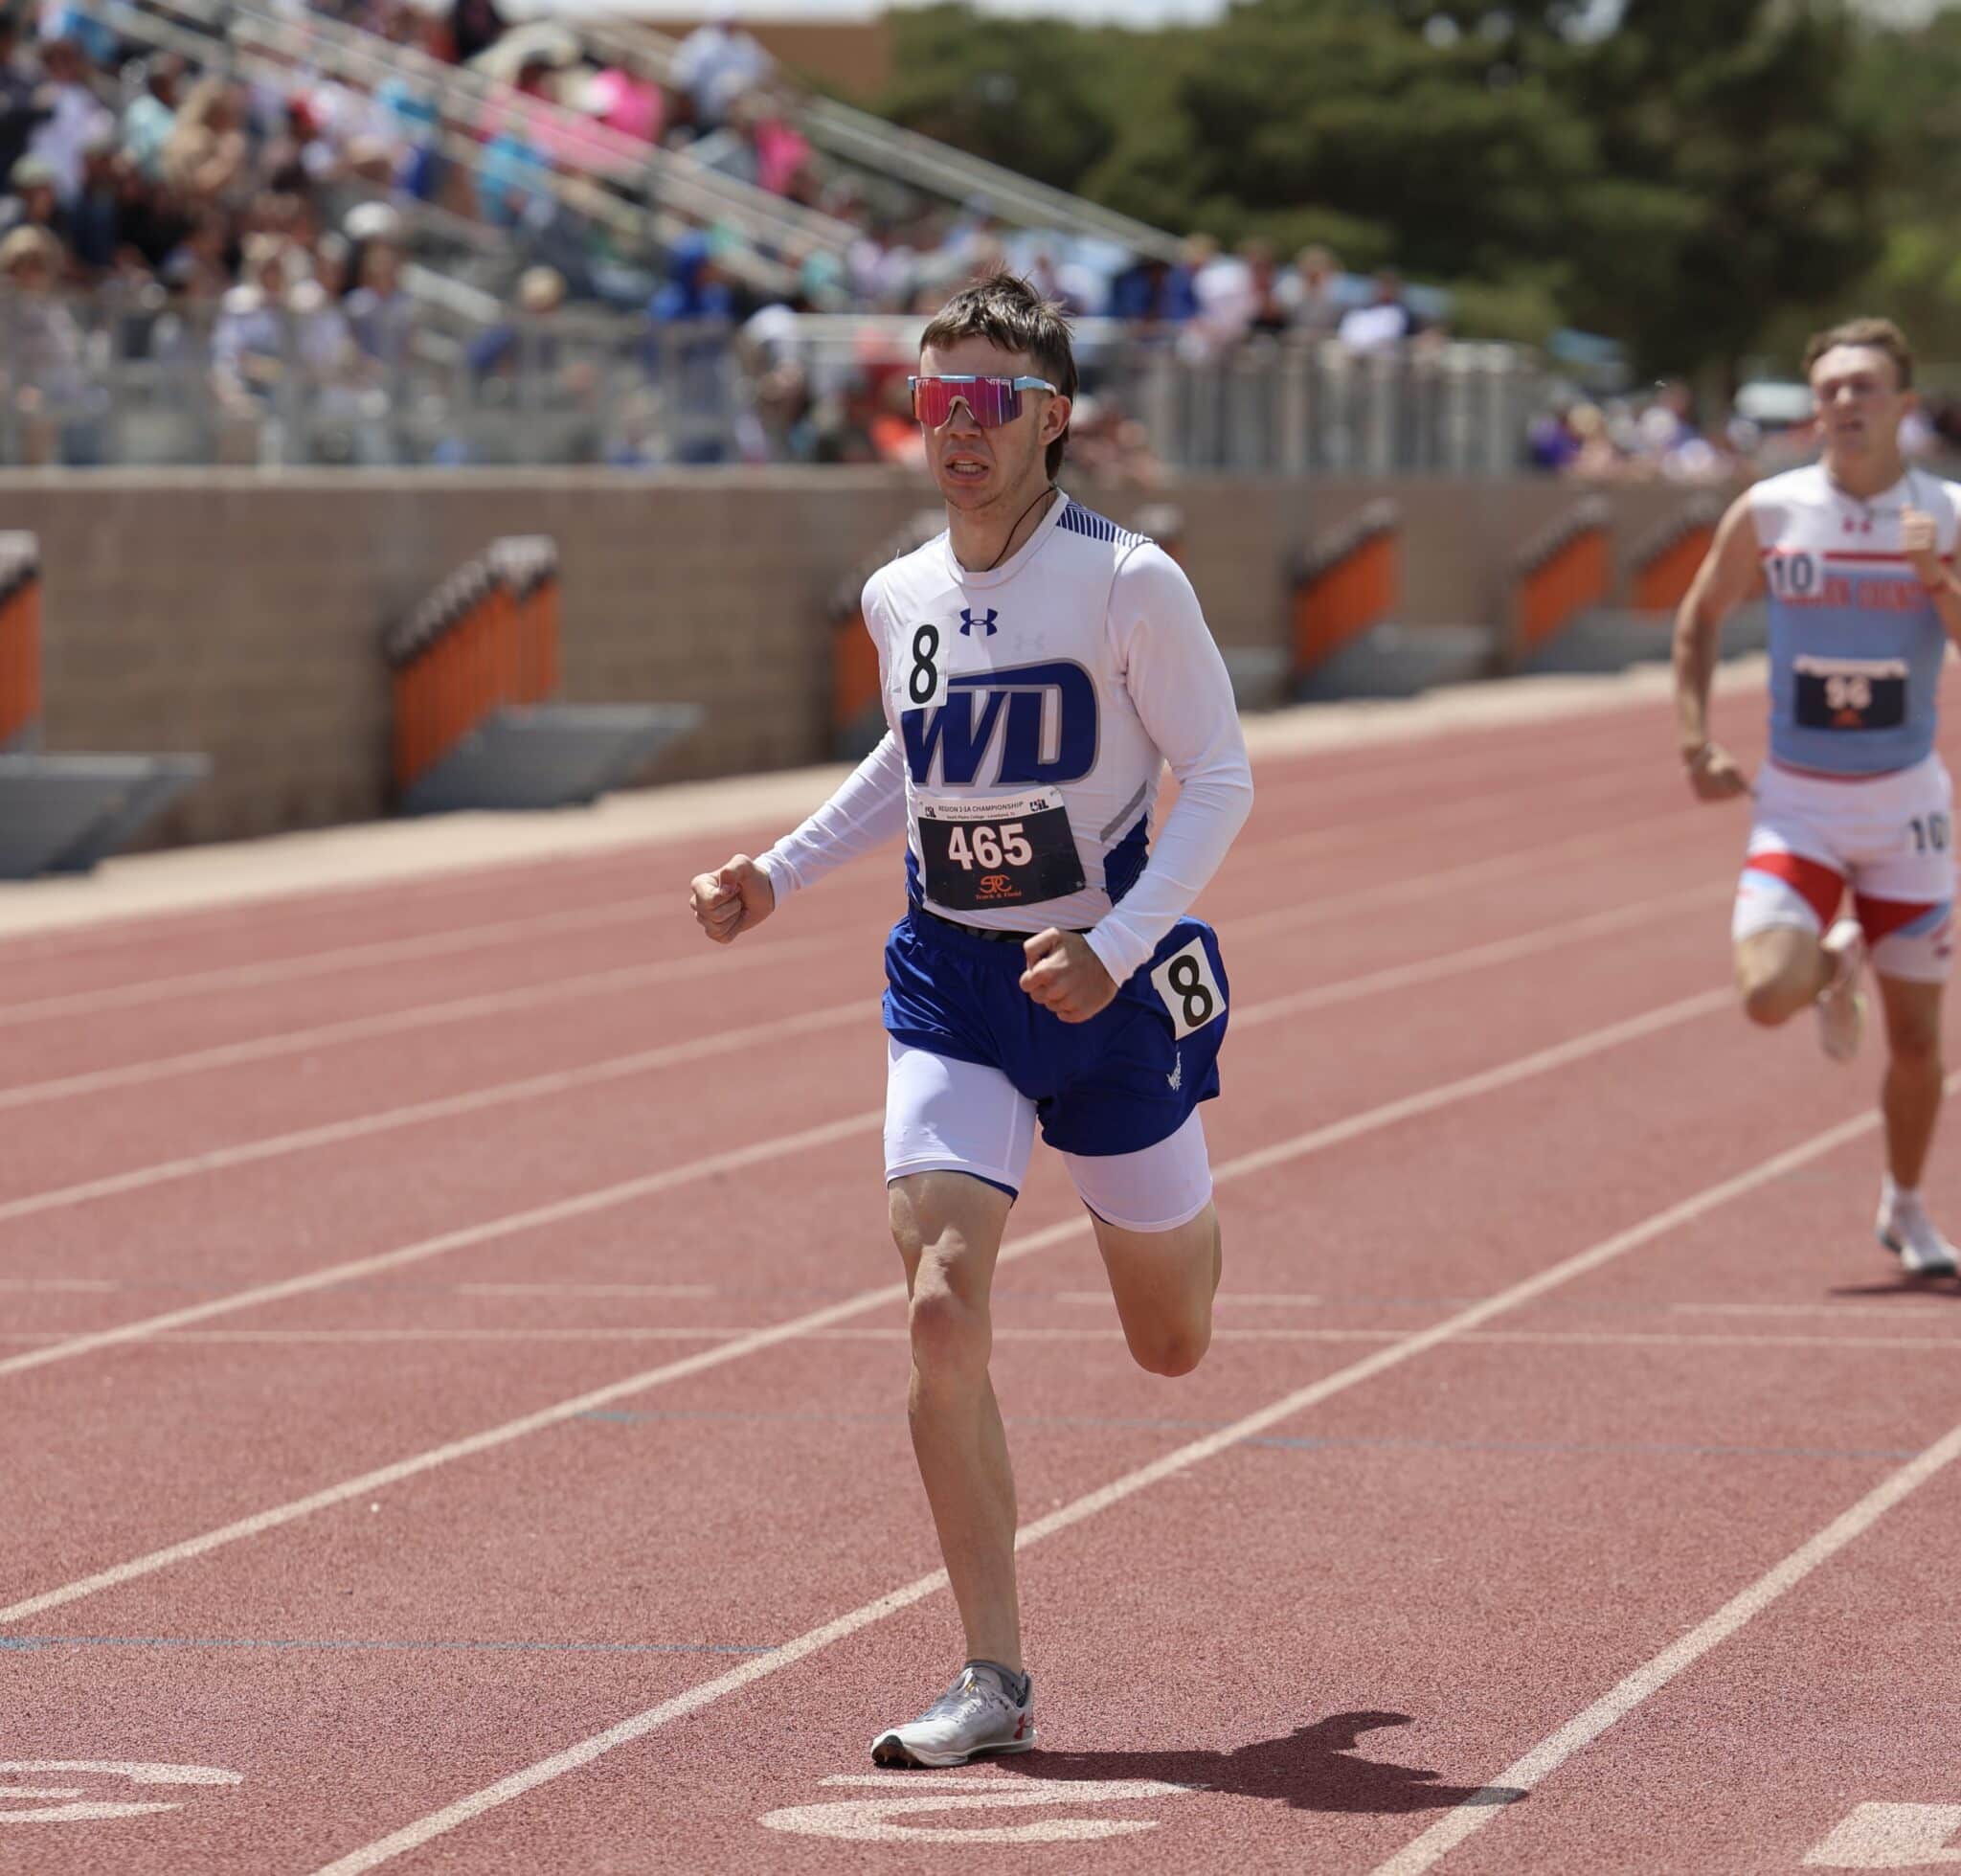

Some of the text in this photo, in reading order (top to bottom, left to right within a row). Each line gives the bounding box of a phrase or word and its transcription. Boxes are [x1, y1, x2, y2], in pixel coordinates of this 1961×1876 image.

[1773, 553, 1814, 594] 10
[909, 623, 940, 705] 8
[900, 657, 1102, 788] WD
[972, 801, 1024, 812] CHAMPIONSHIP
[948, 823, 1032, 870] 465
[1167, 954, 1213, 1028] 8
